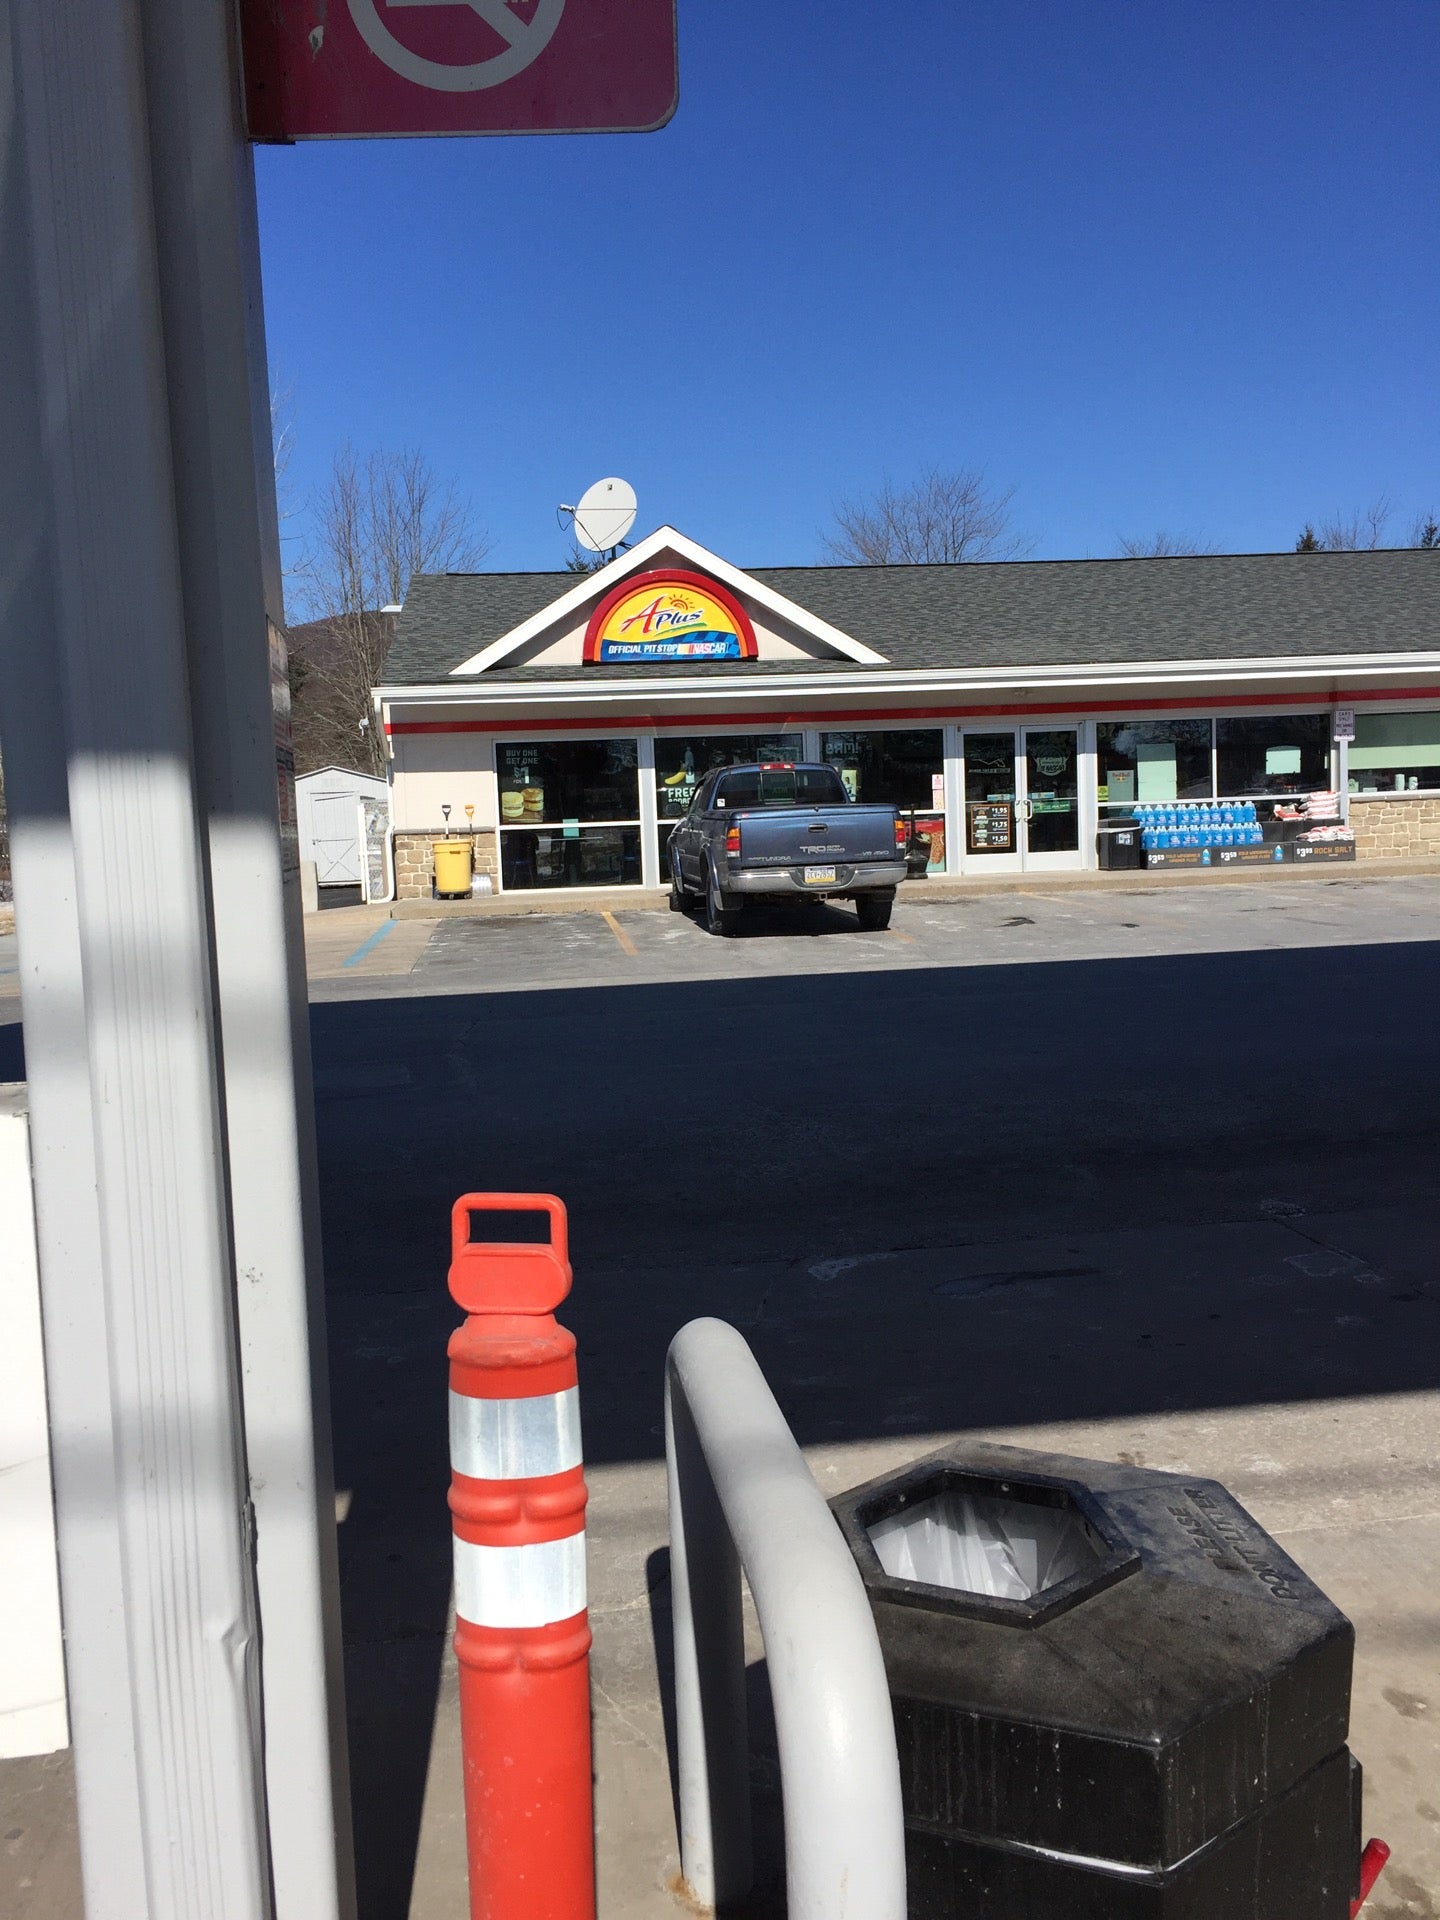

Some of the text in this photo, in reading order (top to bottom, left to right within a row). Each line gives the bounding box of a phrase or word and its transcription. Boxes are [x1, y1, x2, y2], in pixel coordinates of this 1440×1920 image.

[608, 642, 727, 654] OFFICIAL PIT STOP NASCAR
[505, 749, 539, 757] BUY ONE
[505, 757, 539, 765] GET ONE
[513, 767, 530, 784] $1
[1313, 847, 1333, 855] ROCK
[1334, 846, 1353, 854] SALT
[1183, 1488, 1248, 1542] LITTER
[1166, 1505, 1241, 1572] PLEASE
